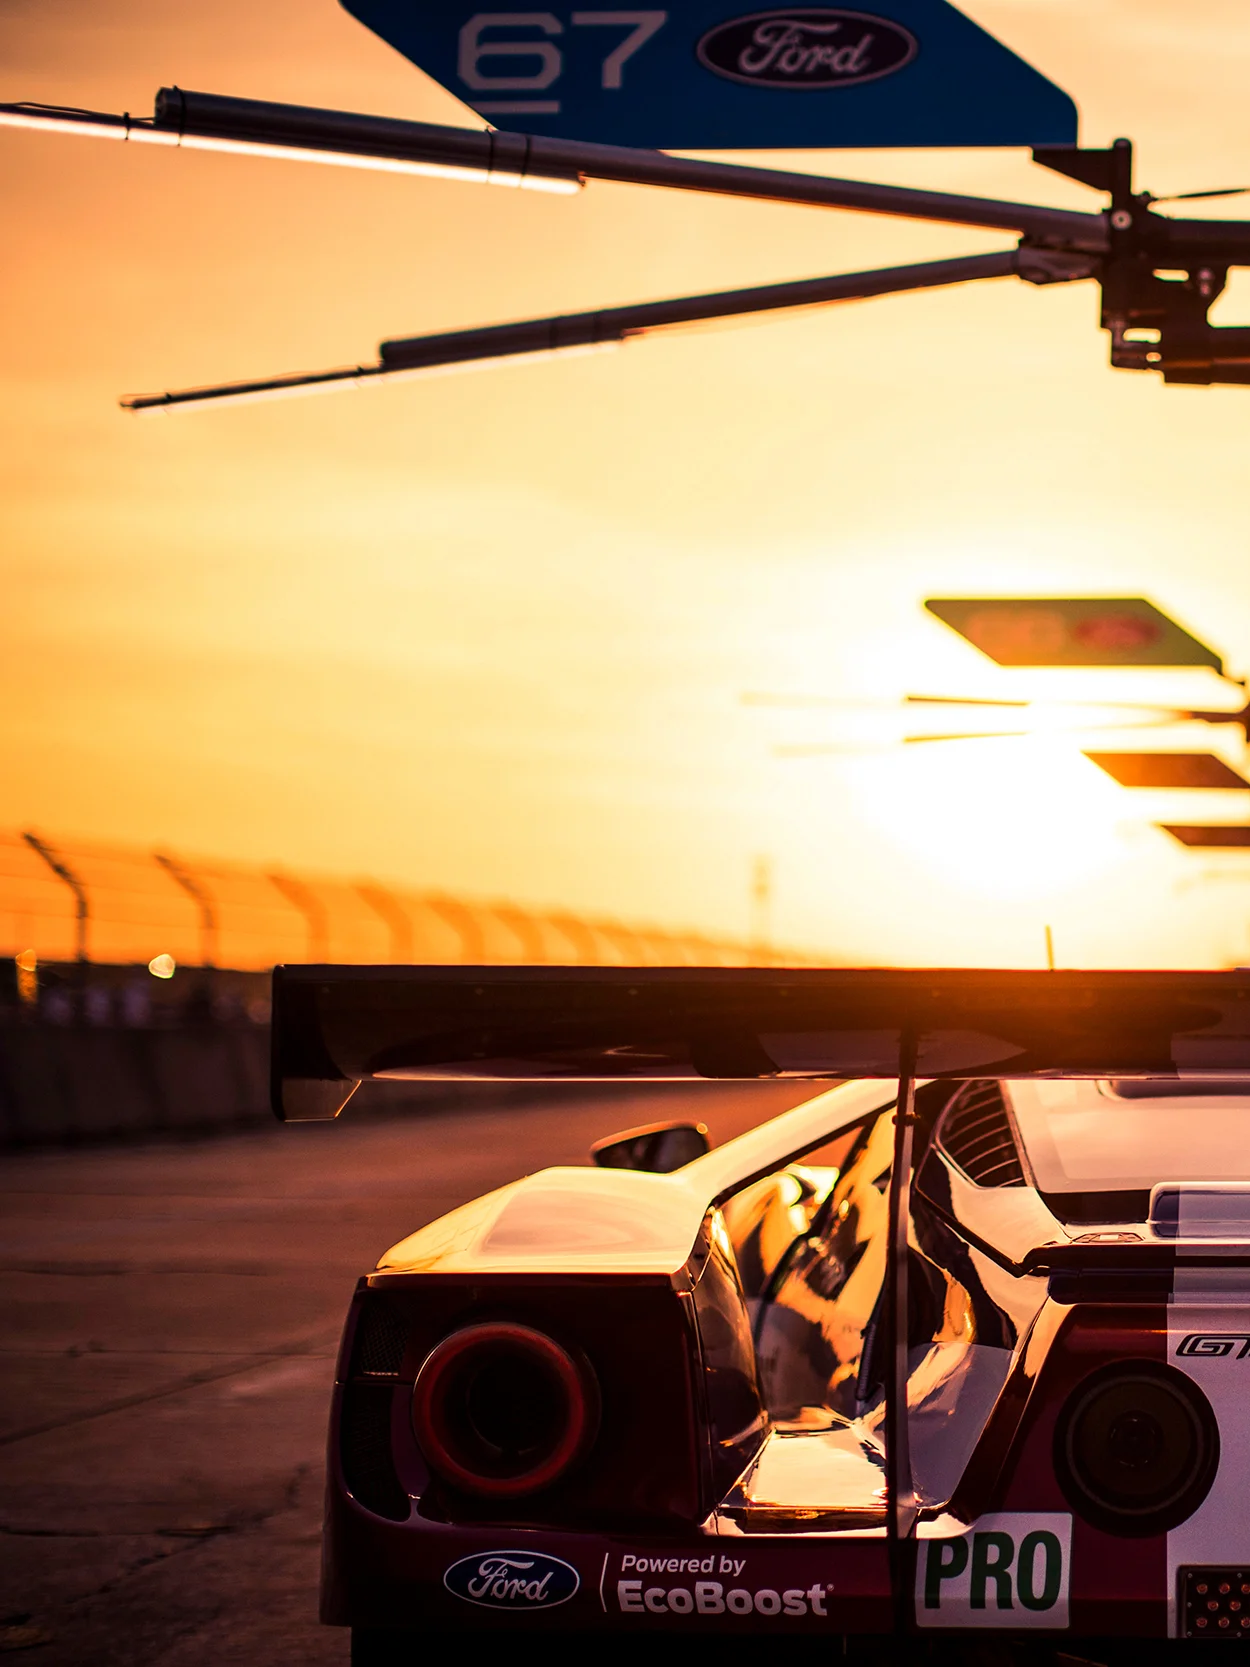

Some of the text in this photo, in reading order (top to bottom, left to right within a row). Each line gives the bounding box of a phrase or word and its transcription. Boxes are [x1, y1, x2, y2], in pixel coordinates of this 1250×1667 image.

[457, 10, 872, 90] 67 Ford
[467, 1558, 554, 1600] Ford
[621, 1554, 746, 1577] Powered by
[923, 1530, 1064, 1612] PRO
